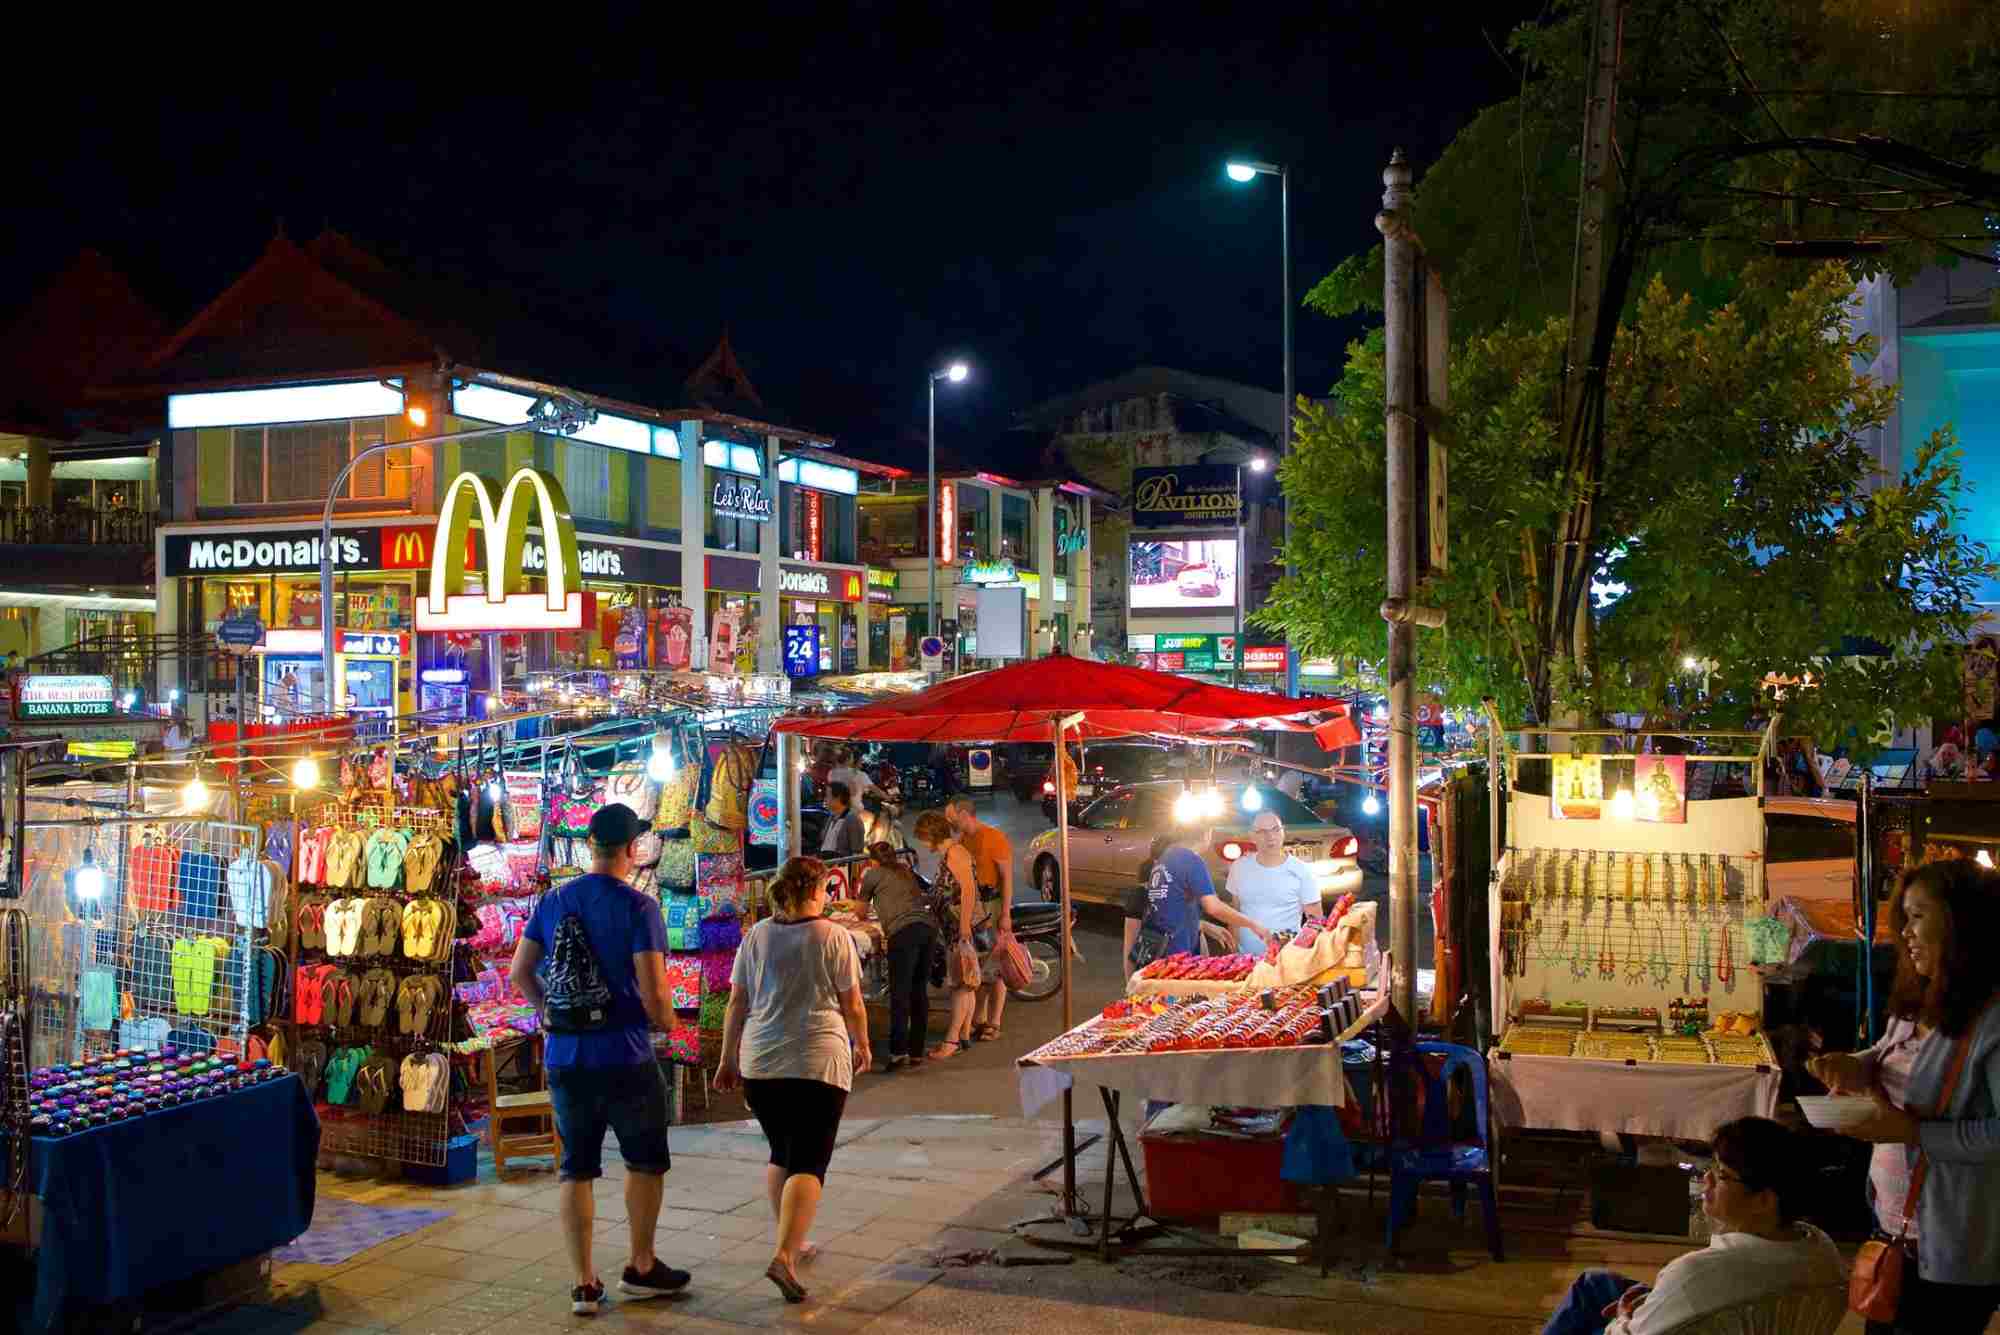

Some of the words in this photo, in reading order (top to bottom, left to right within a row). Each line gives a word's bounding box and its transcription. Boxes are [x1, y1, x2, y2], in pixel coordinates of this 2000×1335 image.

[713, 482, 740, 508] Let's
[788, 640, 813, 659] 24
[28, 703, 71, 715] BANANA
[73, 703, 109, 714] ROTEE
